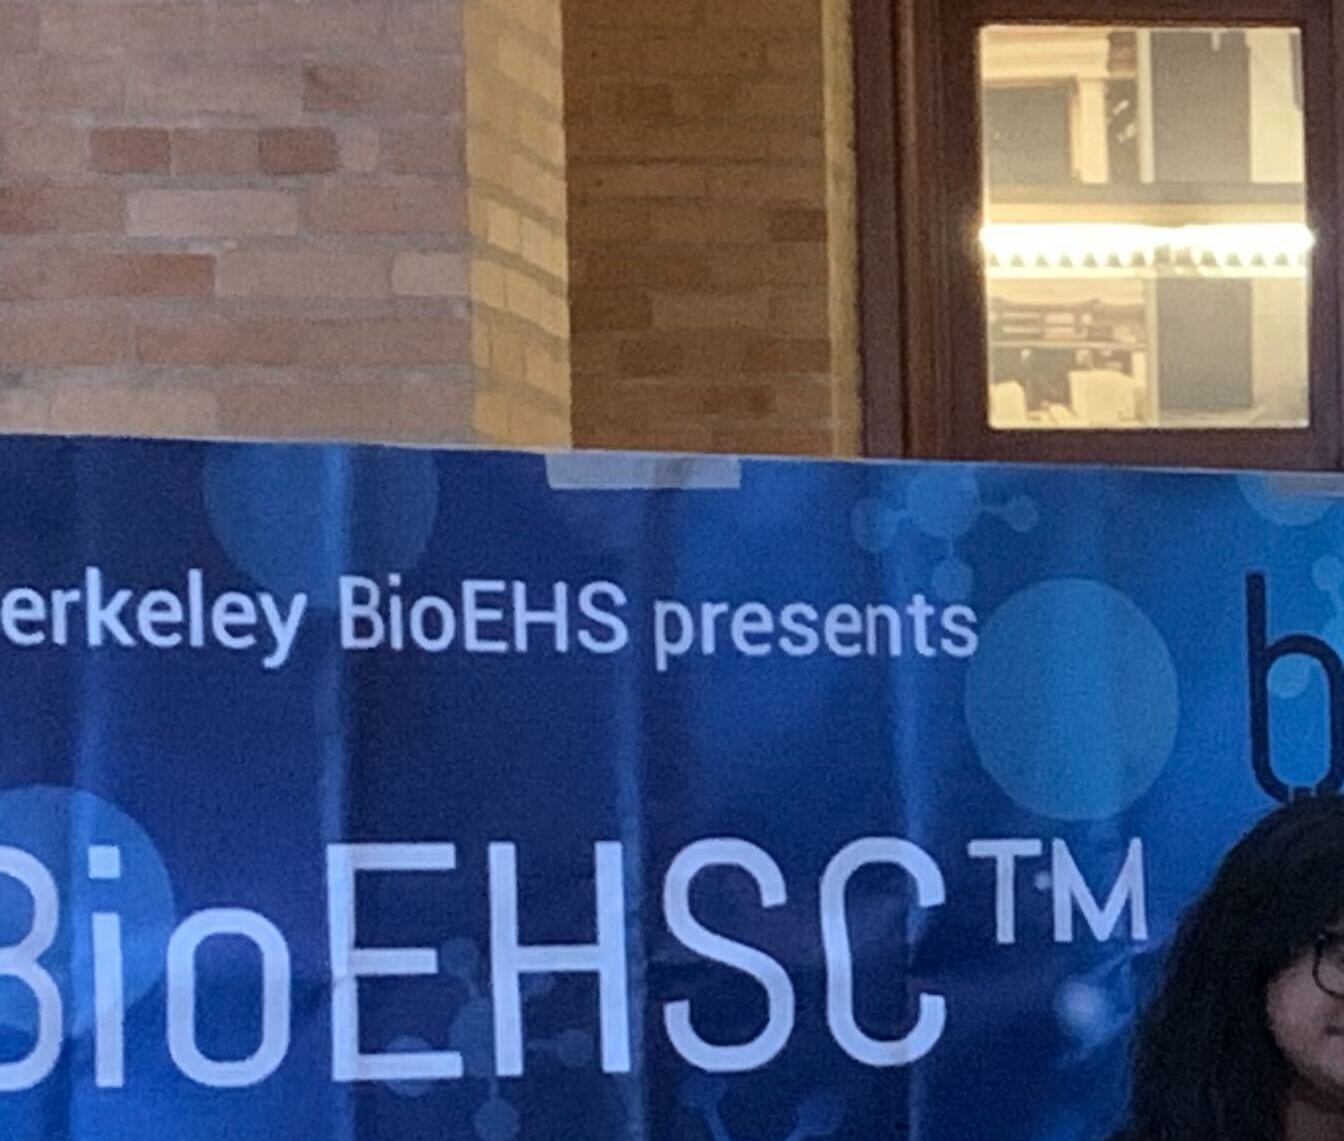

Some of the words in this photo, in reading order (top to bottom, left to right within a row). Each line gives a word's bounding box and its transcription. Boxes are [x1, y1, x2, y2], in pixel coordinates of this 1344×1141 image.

[0, 565, 308, 669] erkeley
[339, 574, 629, 653] BioEHS
[655, 594, 980, 671] presents
